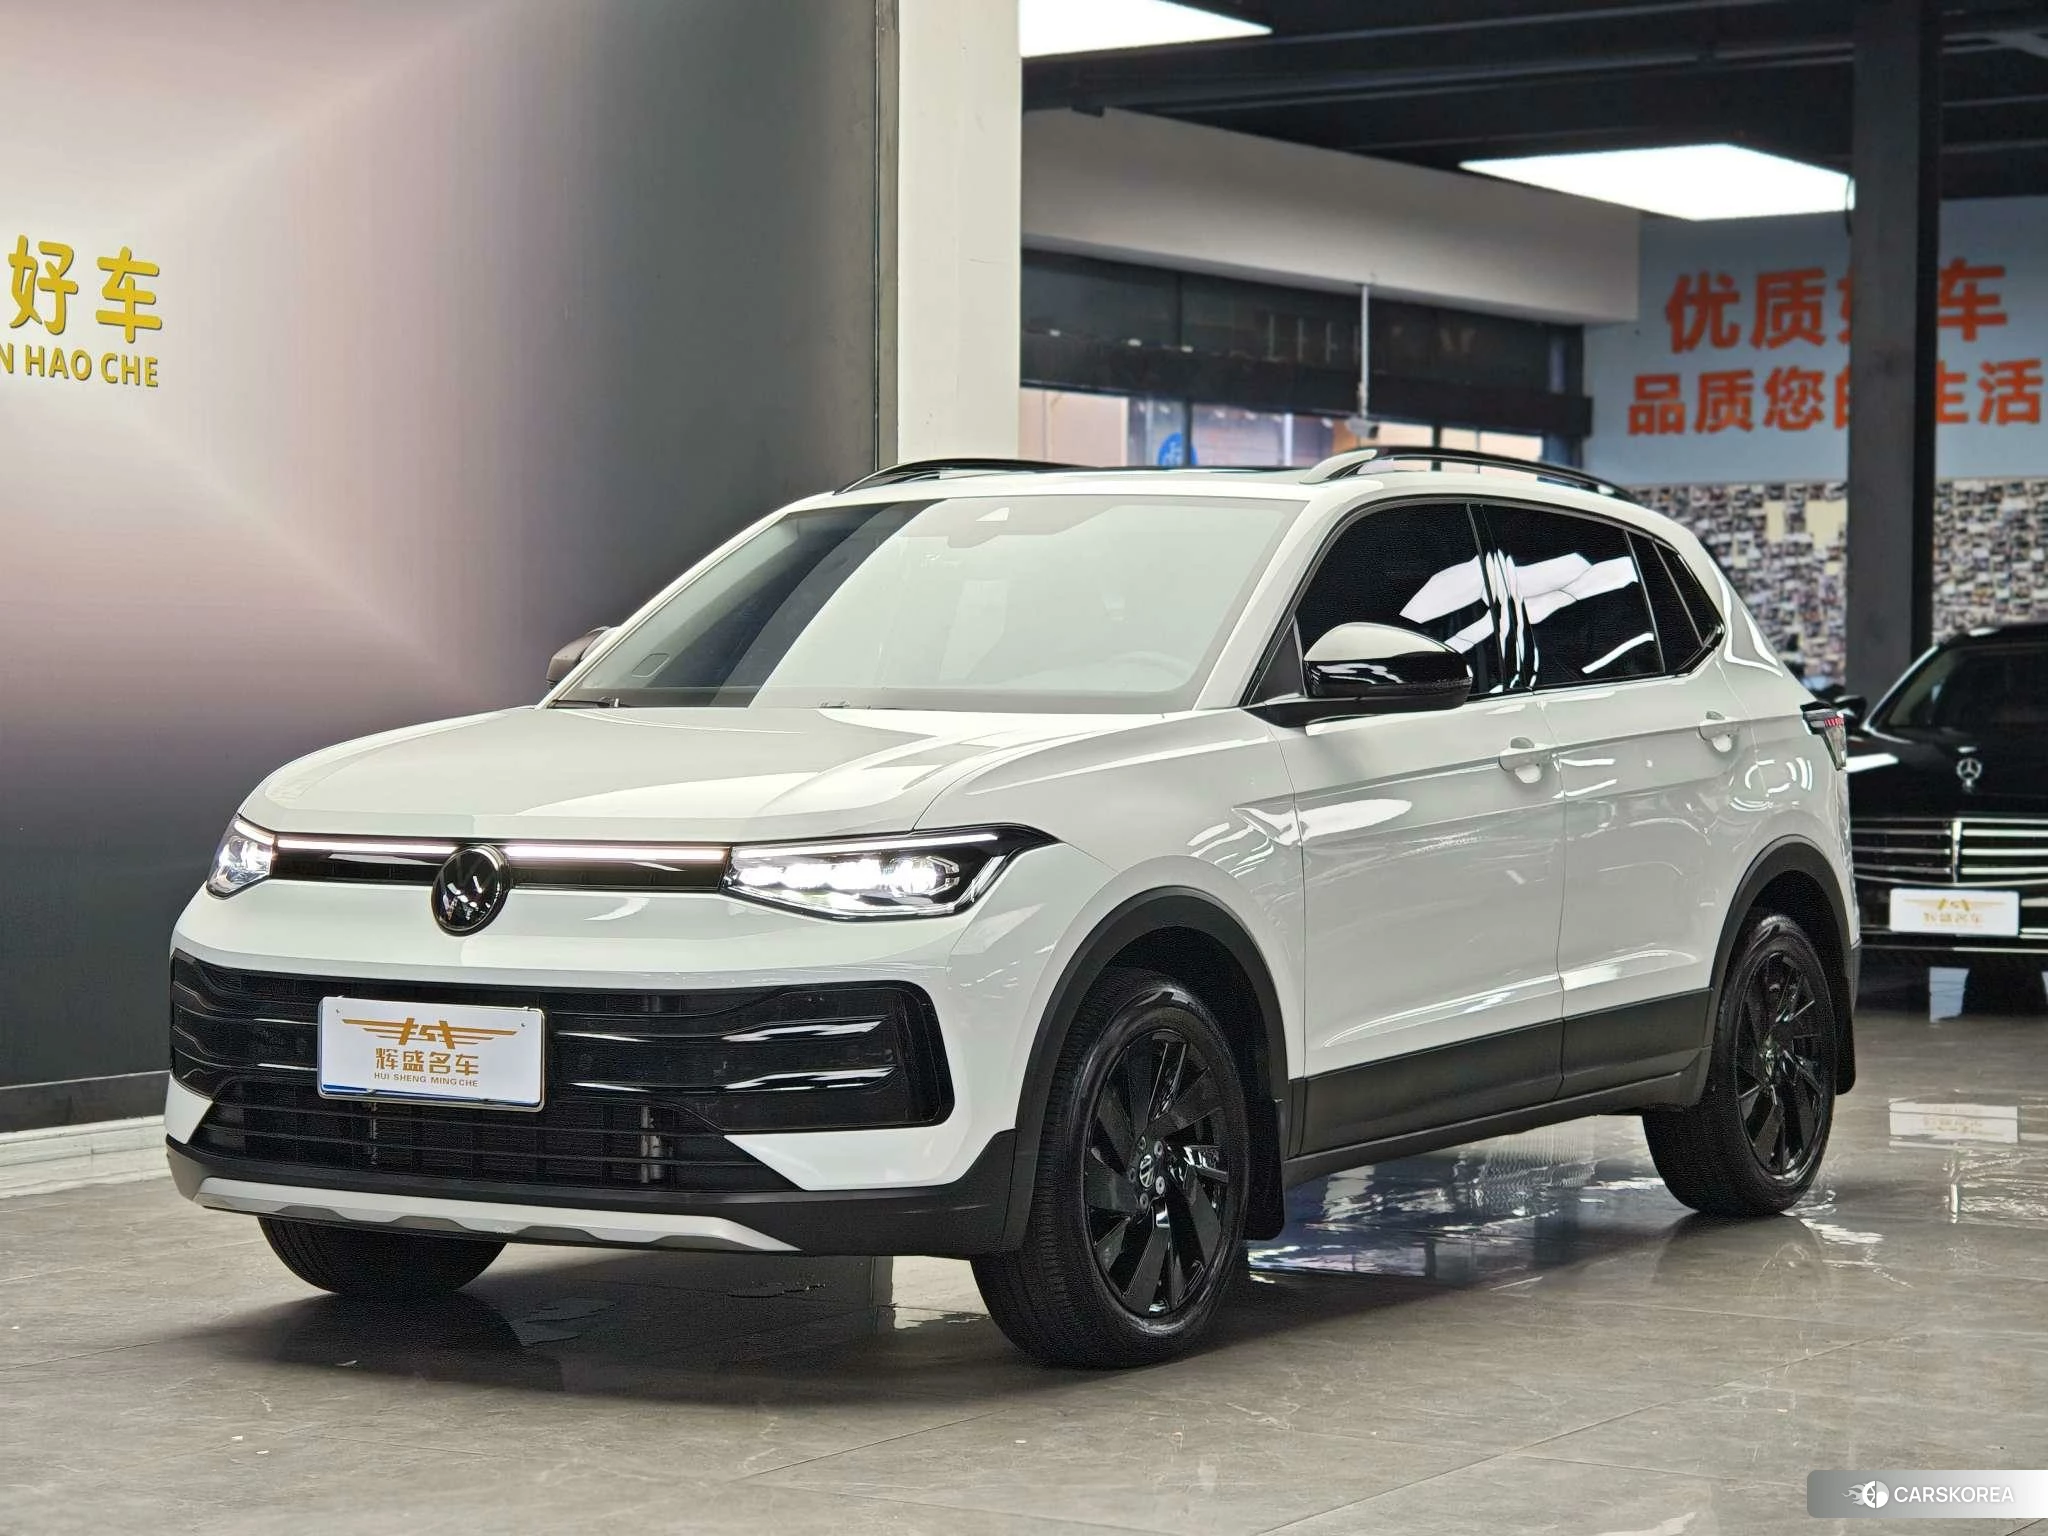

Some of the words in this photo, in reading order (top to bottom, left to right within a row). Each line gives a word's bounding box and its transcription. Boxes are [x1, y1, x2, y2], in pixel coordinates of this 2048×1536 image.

[8, 235, 162, 343] 好车
[1666, 256, 2007, 354] 优质车
[25, 344, 92, 380] HAO
[101, 352, 158, 387] CHE
[1628, 359, 2044, 436] 品质您生活
[374, 1072, 390, 1081] HUI
[393, 1073, 427, 1084] SHENG
[430, 1076, 457, 1086] MING
[458, 1079, 479, 1088] CHE
[375, 1047, 479, 1076] 辉盛名车
